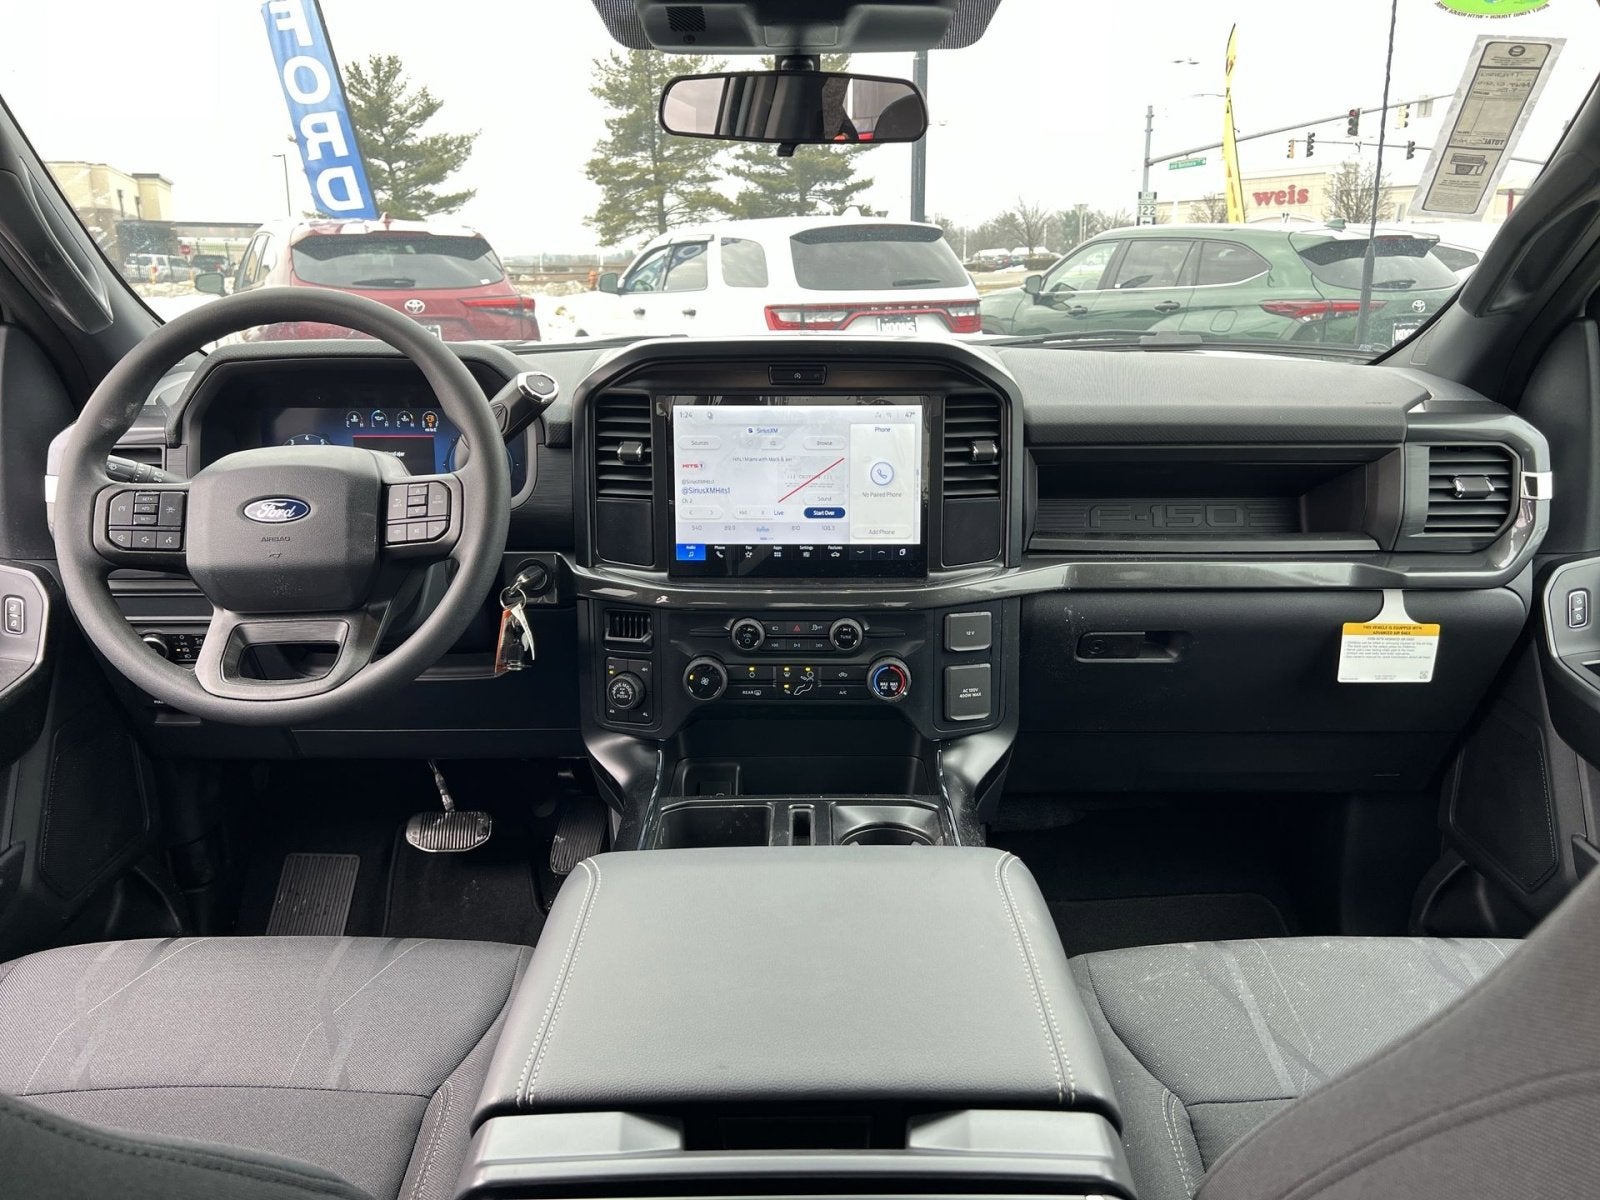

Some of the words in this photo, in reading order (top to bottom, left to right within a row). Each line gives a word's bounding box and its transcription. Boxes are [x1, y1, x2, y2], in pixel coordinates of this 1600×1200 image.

[1252, 185, 1309, 206] weis
[1138, 205, 1156, 215] 122
[257, 502, 297, 518] Ford
[1089, 504, 1246, 527] F-150
